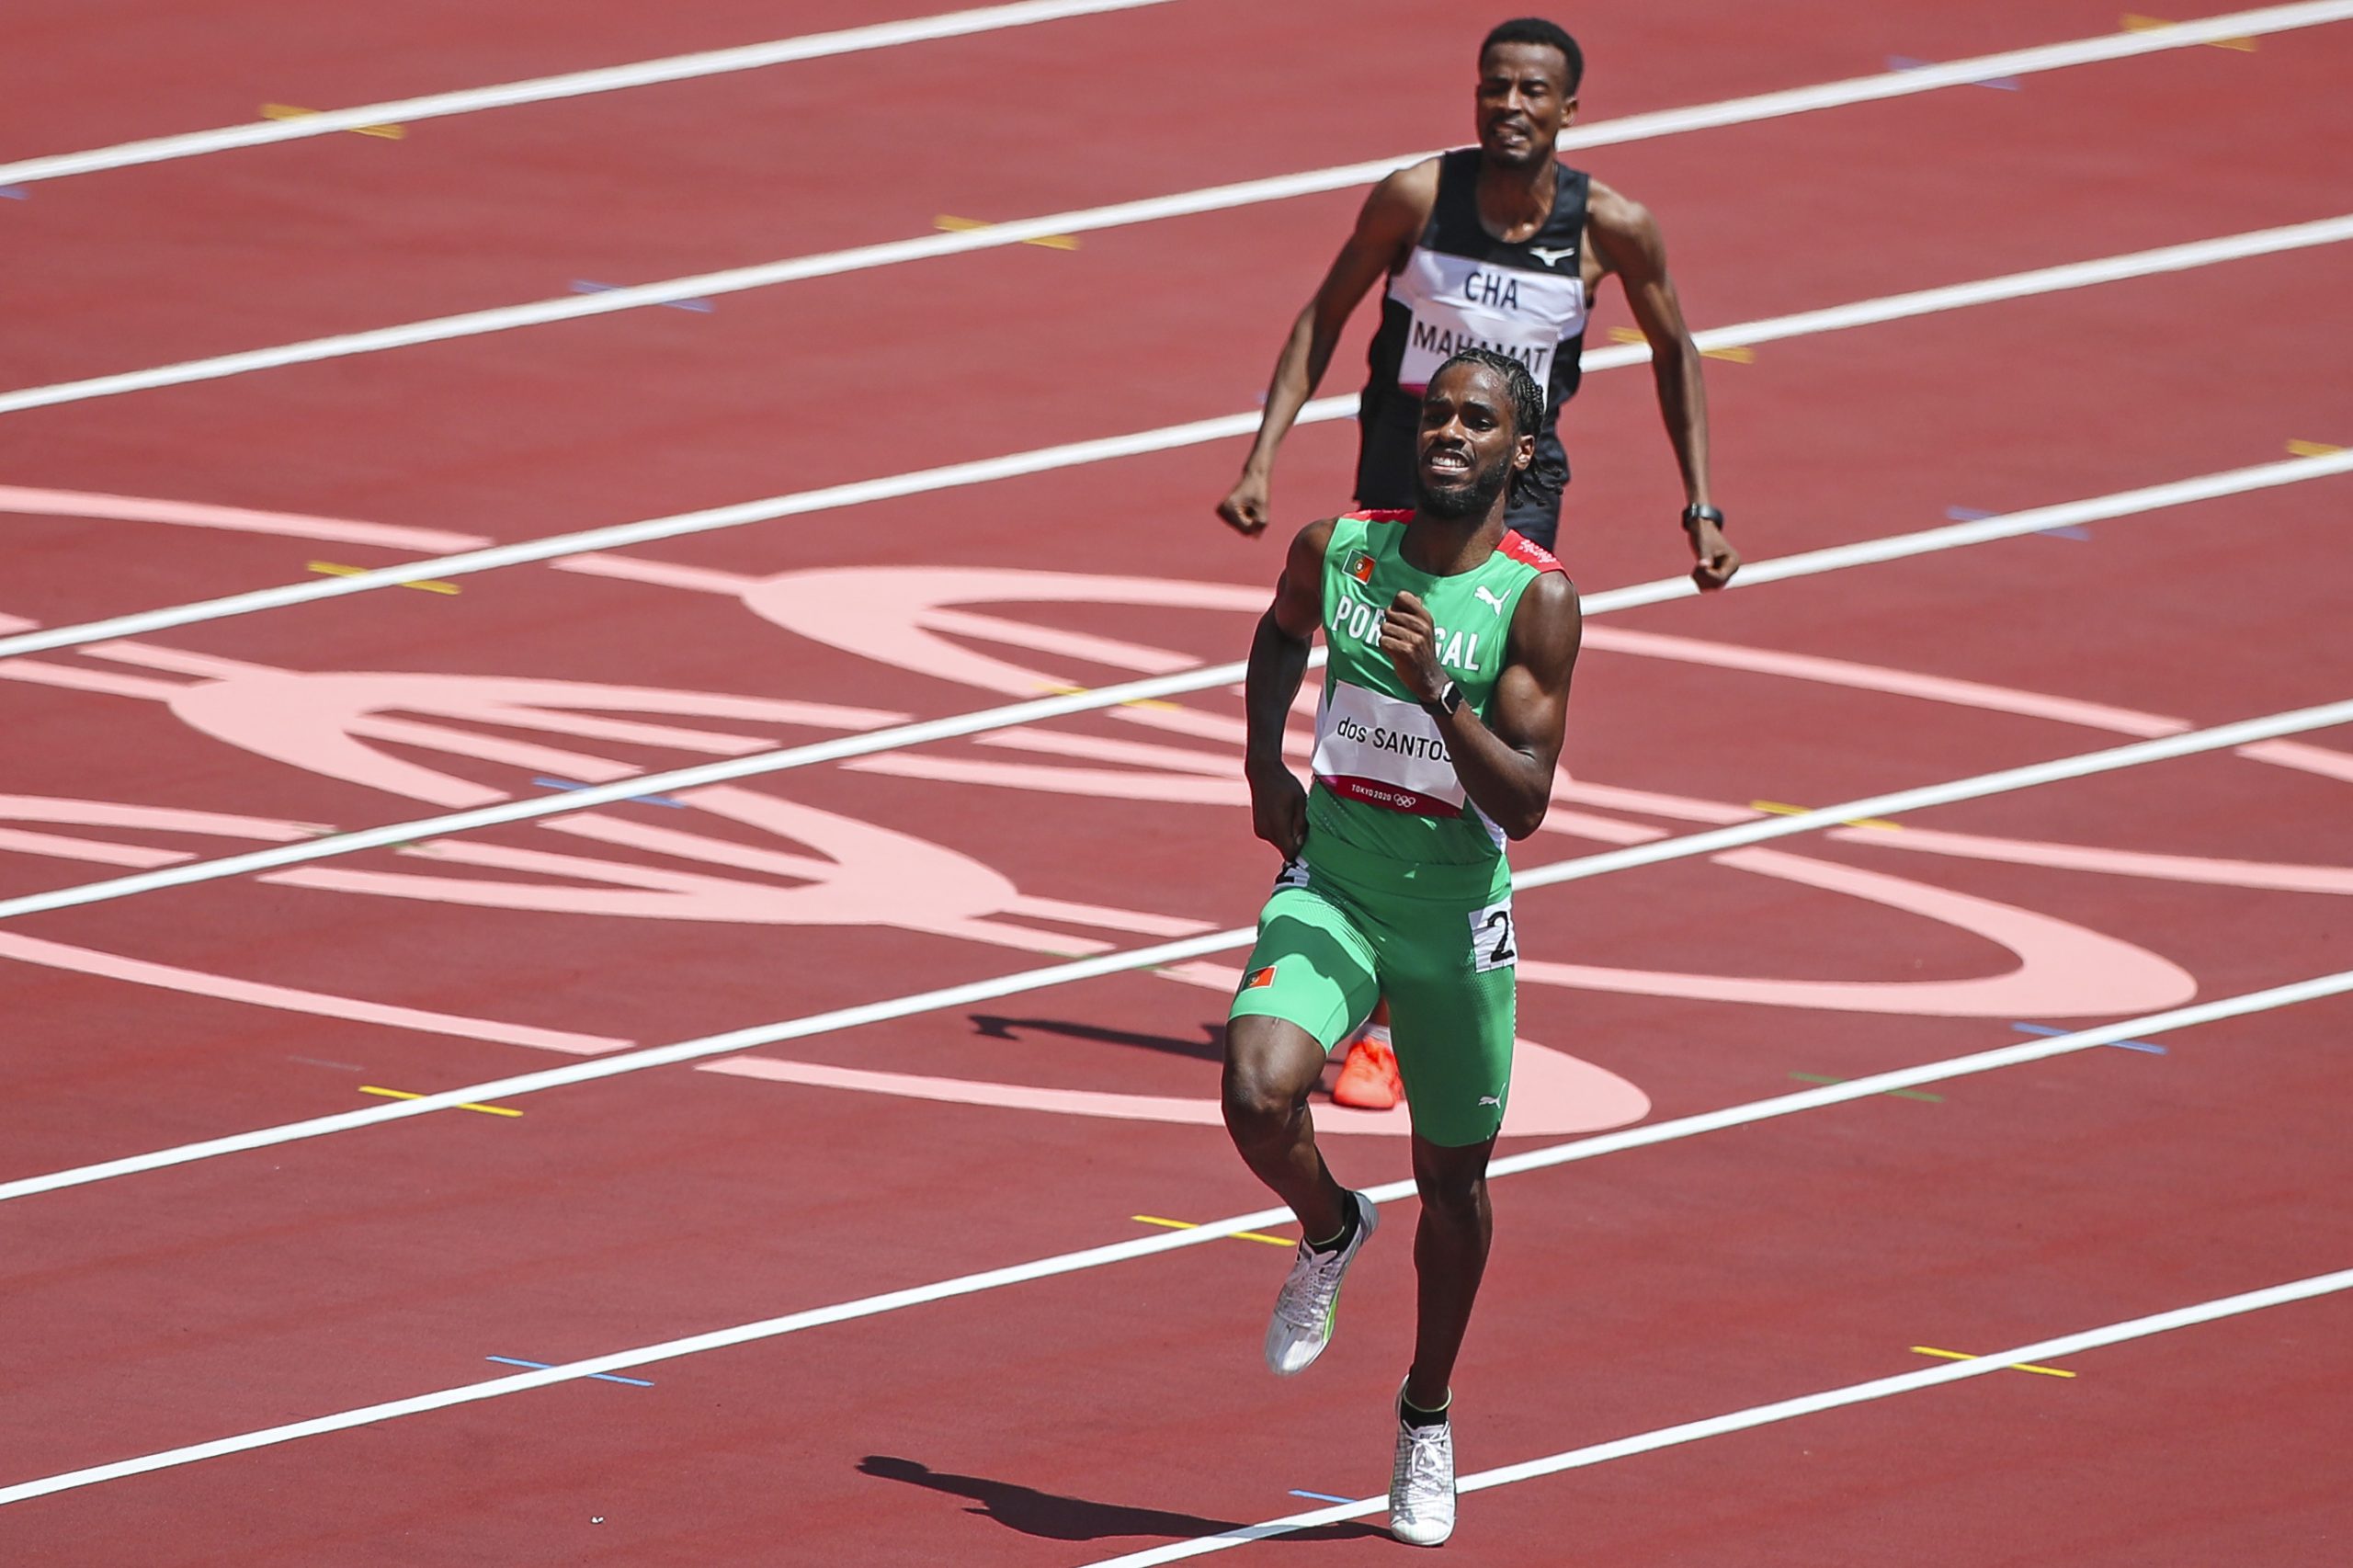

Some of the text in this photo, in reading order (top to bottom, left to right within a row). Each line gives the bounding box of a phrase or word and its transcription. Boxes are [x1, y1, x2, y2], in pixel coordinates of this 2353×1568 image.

[1465, 271, 1518, 310] CHA
[1337, 717, 1368, 743] dos
[1351, 784, 1392, 801] TOKYO 2020
[1486, 910, 1516, 963] 2
